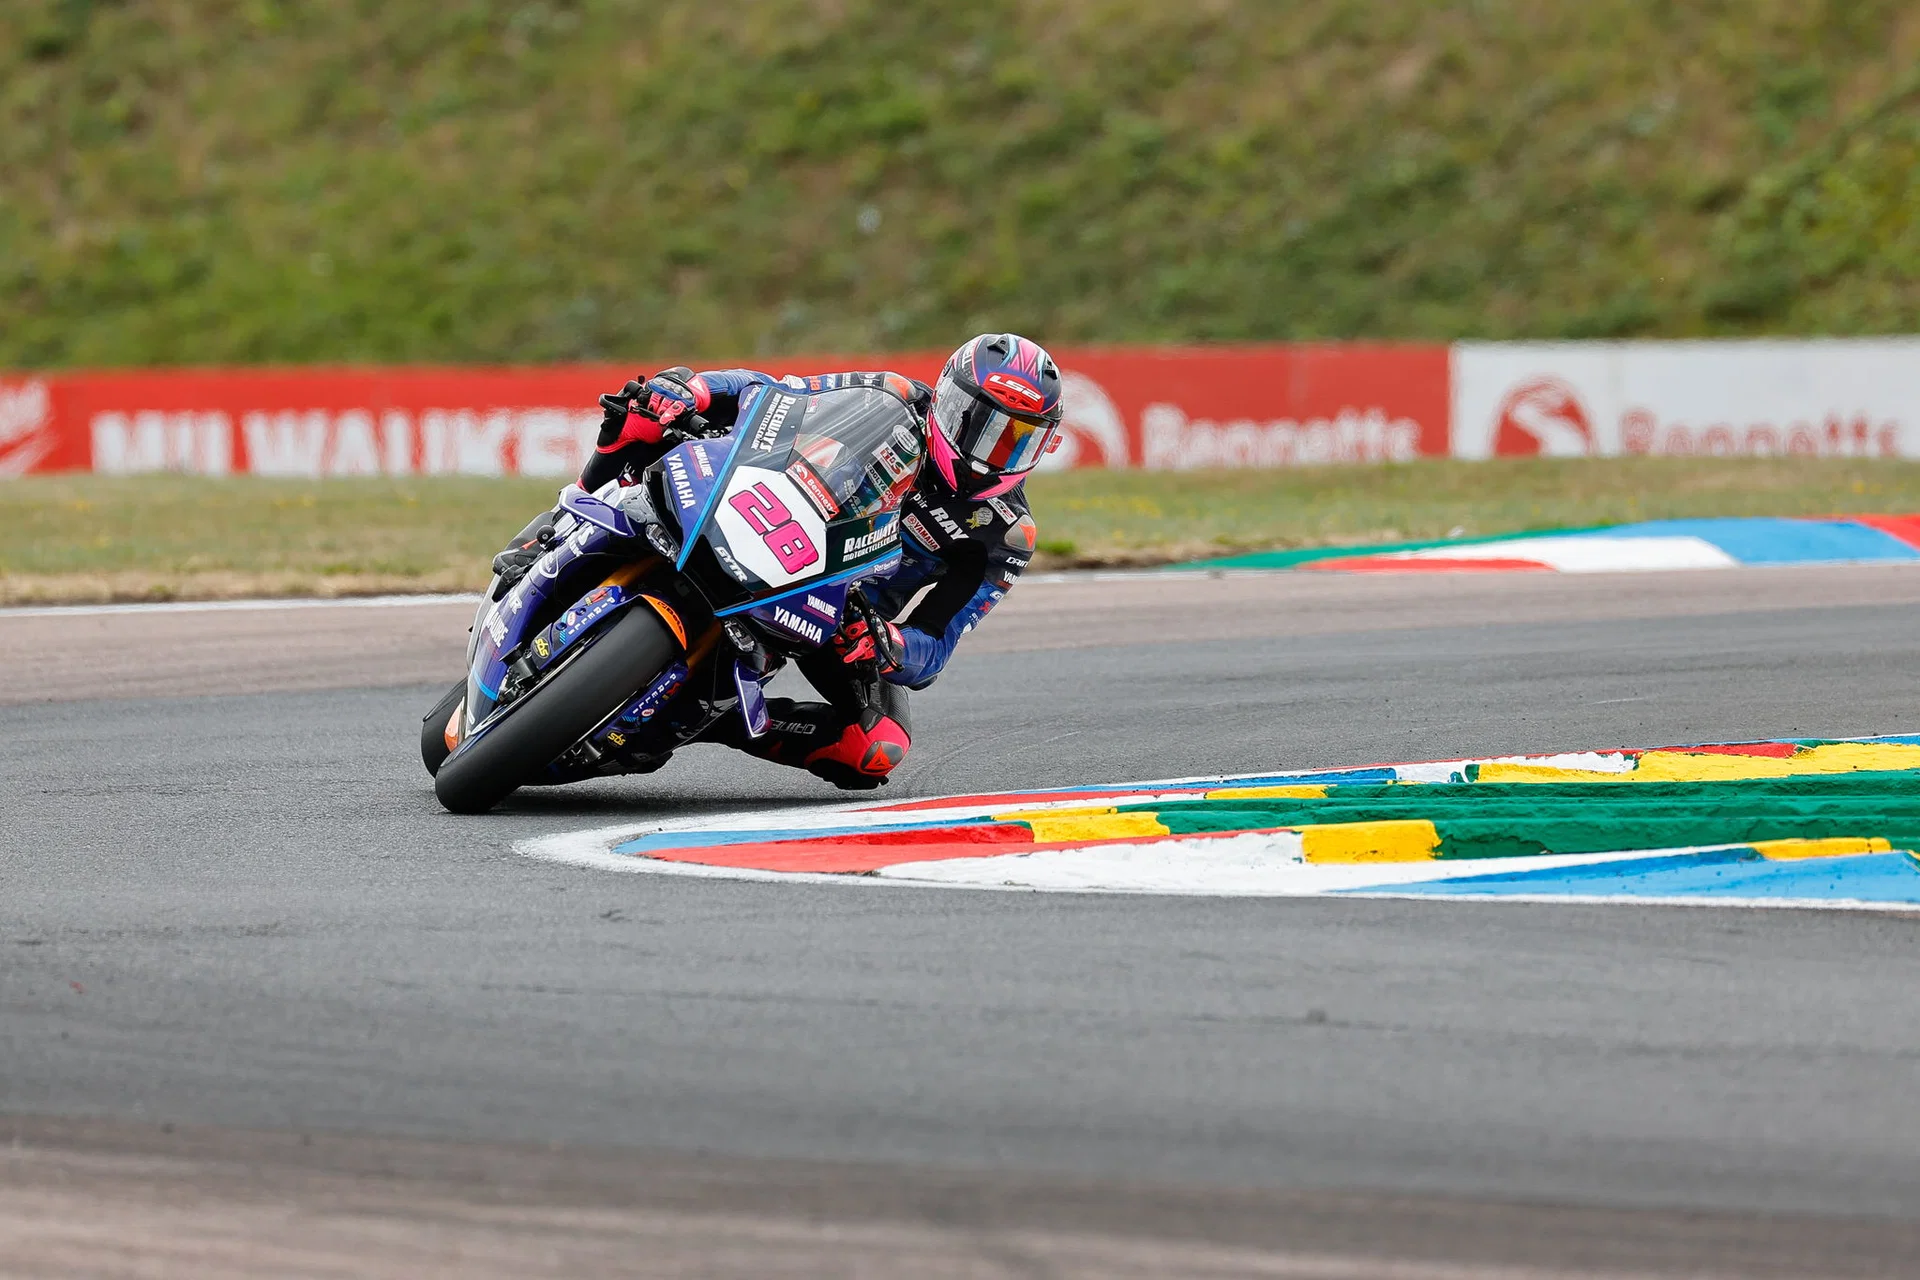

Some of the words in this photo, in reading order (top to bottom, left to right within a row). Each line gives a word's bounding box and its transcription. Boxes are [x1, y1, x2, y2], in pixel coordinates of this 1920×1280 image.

[989, 374, 1042, 402] LS2
[760, 395, 797, 453] RACEWAYS
[692, 444, 715, 478] YAMALUBE
[667, 453, 696, 509] YAMAHA
[806, 478, 835, 514] Bennett
[728, 481, 819, 575] 28
[843, 520, 900, 554] RACEWAYS
[912, 522, 939, 551] YAMAHA
[929, 507, 969, 541] RAY
[714, 546, 748, 582] GYTR
[568, 597, 616, 635] PIRELLI
[807, 594, 838, 619] YAMALUBE
[773, 606, 823, 644] YAMAHA
[535, 638, 550, 657] sbs
[632, 673, 677, 714] PIRELLI
[607, 732, 626, 747] sbs
[770, 719, 816, 735] DAINE
